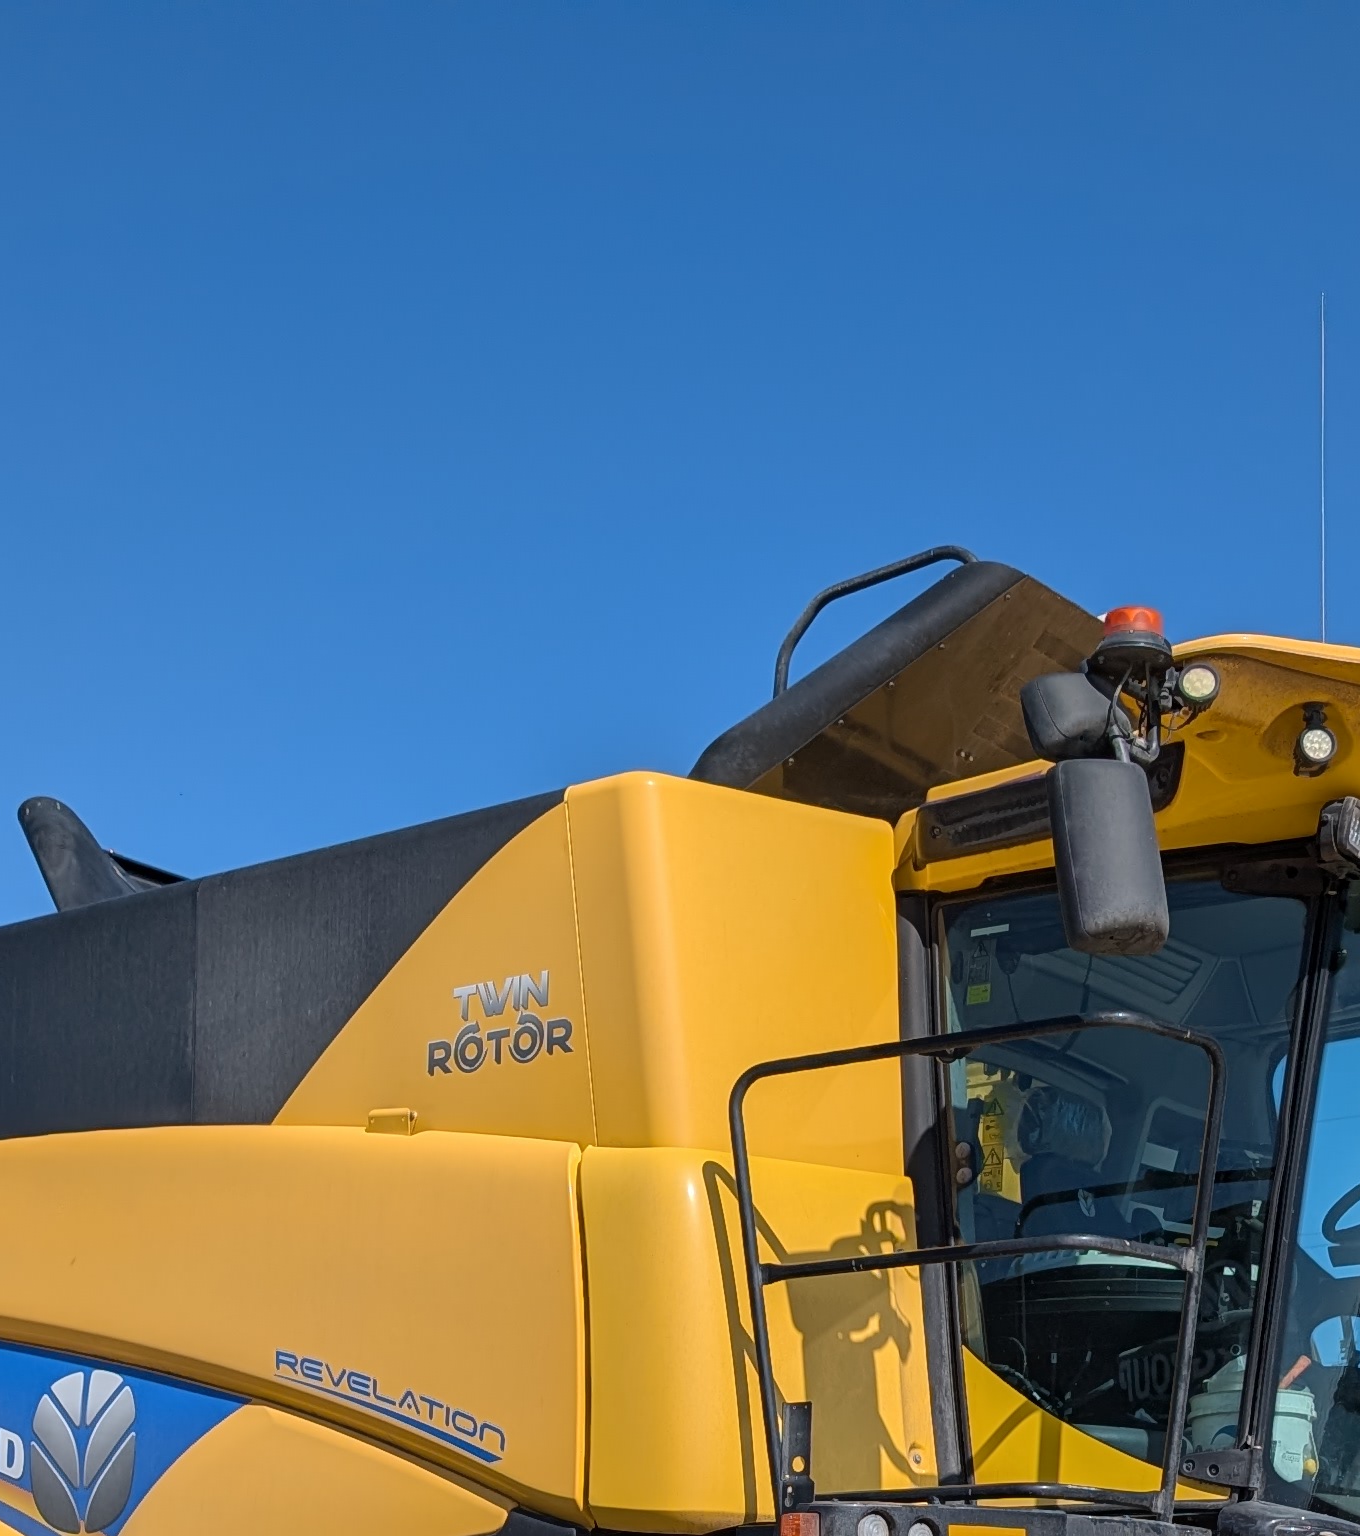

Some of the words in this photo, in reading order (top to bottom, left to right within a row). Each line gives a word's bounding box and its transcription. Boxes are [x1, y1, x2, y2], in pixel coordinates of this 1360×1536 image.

[453, 970, 550, 1020] TWIN
[427, 1012, 574, 1077] ROTOR
[274, 1348, 506, 1452] REVELATION
